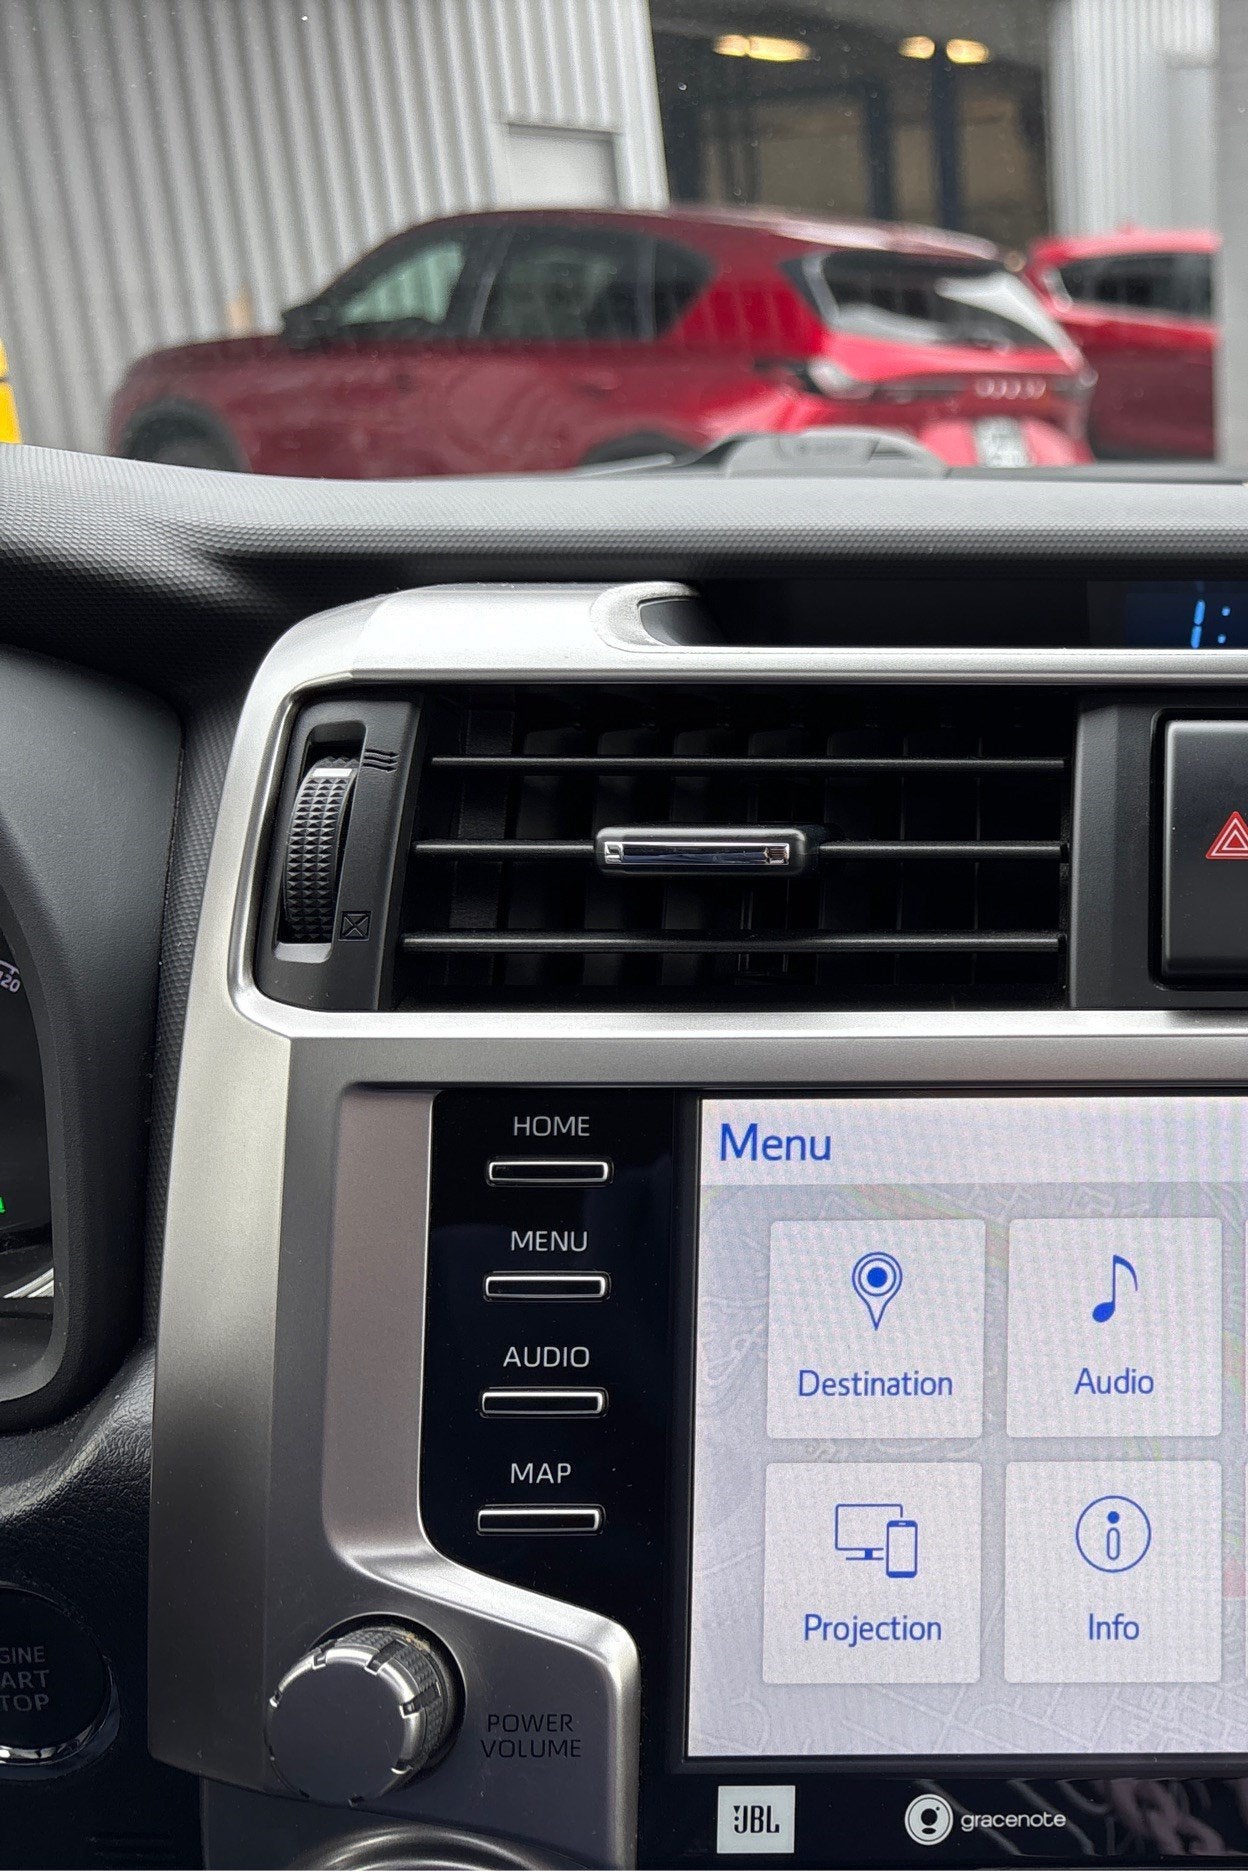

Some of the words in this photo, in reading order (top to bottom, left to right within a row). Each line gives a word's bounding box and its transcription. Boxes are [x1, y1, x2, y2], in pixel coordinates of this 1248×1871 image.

[514, 1116, 589, 1136] HOME
[721, 1123, 830, 1161] Menu
[511, 1231, 587, 1252] MENU
[503, 1347, 589, 1367] AUDIO
[799, 1370, 952, 1396] Destination
[1074, 1367, 1154, 1394] Audio
[511, 1463, 571, 1483] MAP
[805, 1614, 941, 1647] Projection
[1089, 1613, 1139, 1640] Info
[487, 1714, 573, 1733] POWER
[480, 1740, 580, 1758] VOLUME
[734, 1806, 779, 1833] JBL
[961, 1812, 1066, 1832] gracenote
